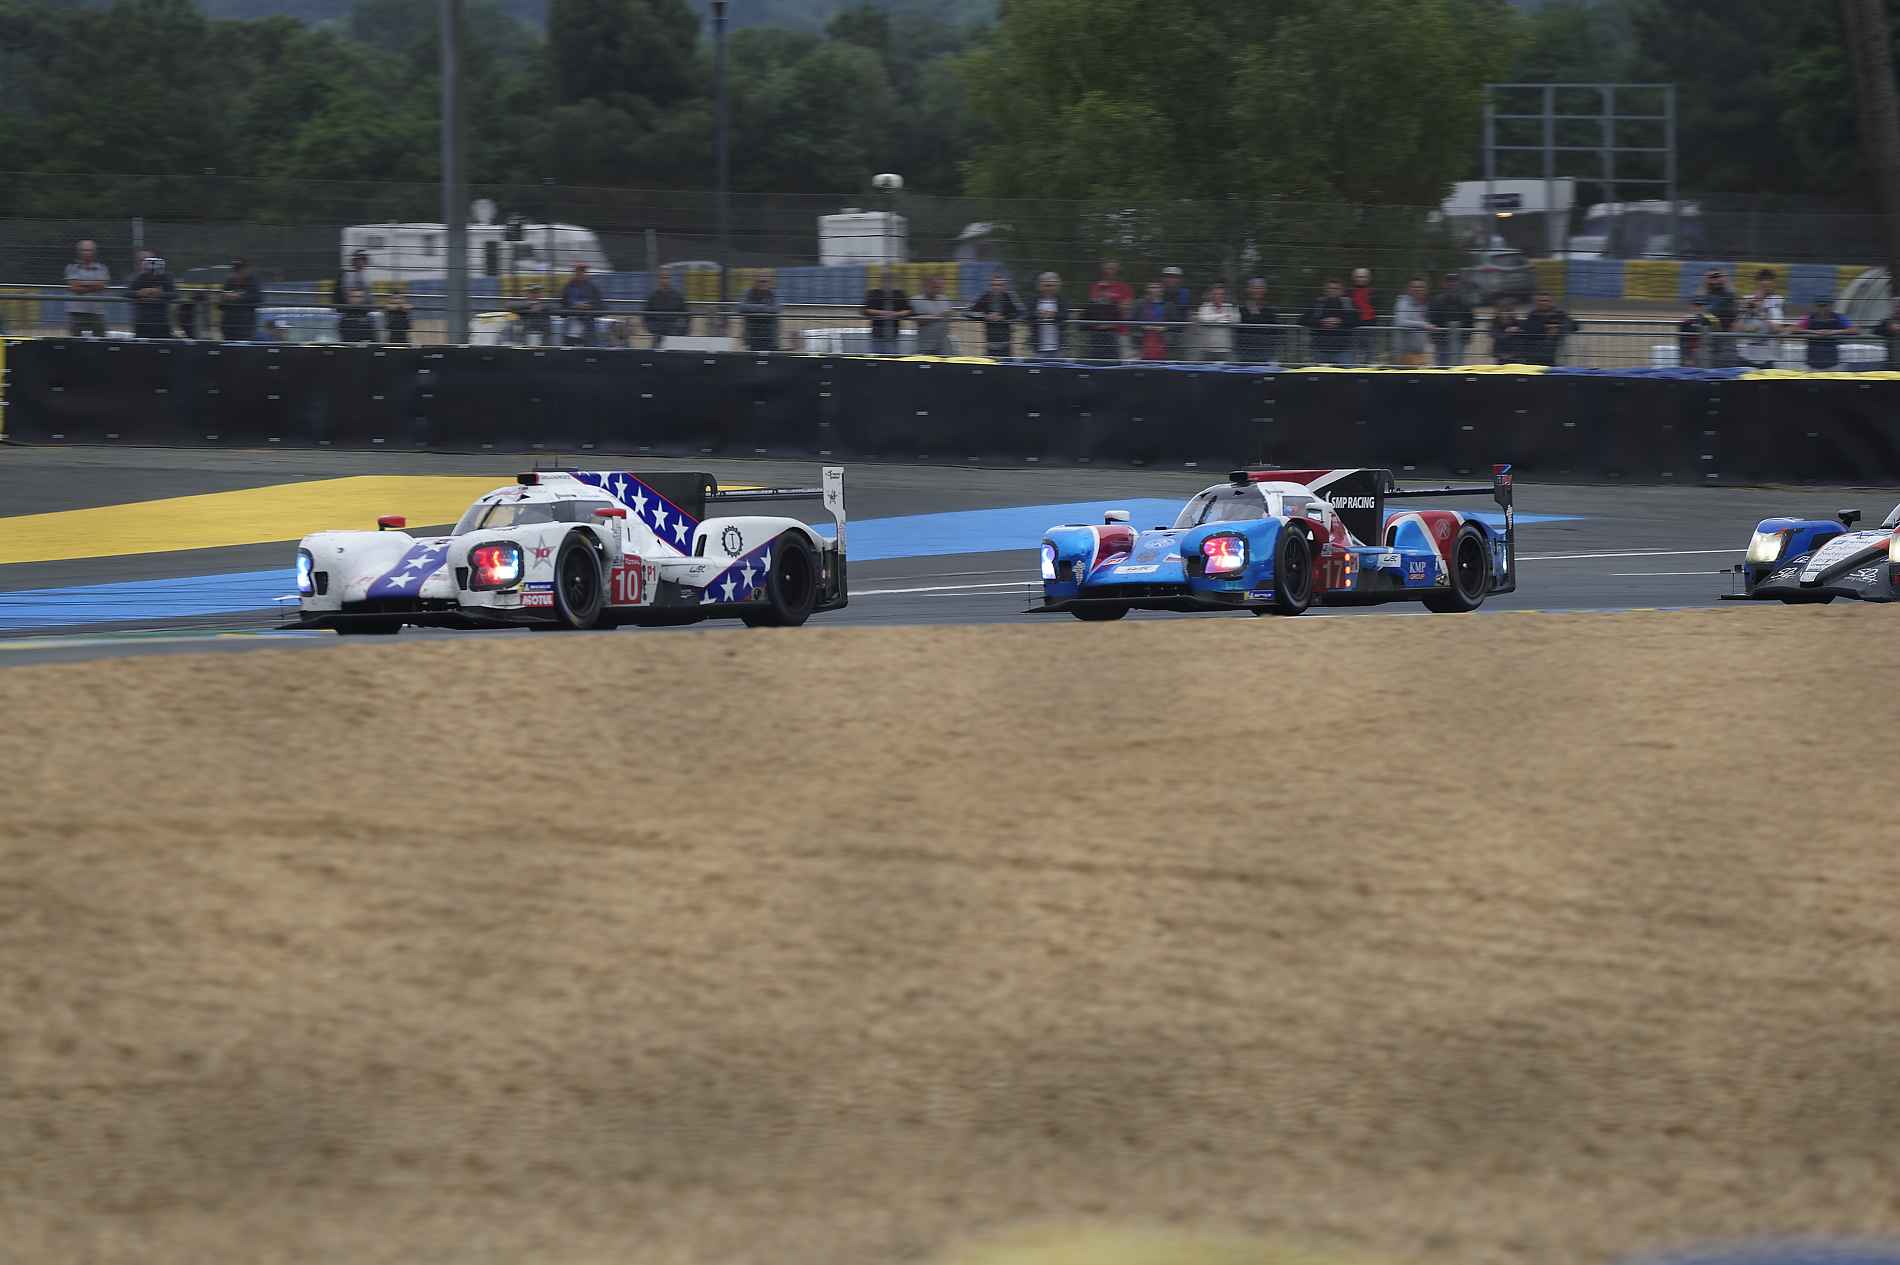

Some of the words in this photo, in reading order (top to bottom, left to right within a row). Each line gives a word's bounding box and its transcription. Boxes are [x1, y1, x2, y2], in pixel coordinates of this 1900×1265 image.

[1331, 497, 1347, 509] SMP
[1348, 497, 1375, 509] RACING
[1323, 560, 1343, 588] 17
[1409, 562, 1426, 573] KMP
[616, 570, 638, 600] 10
